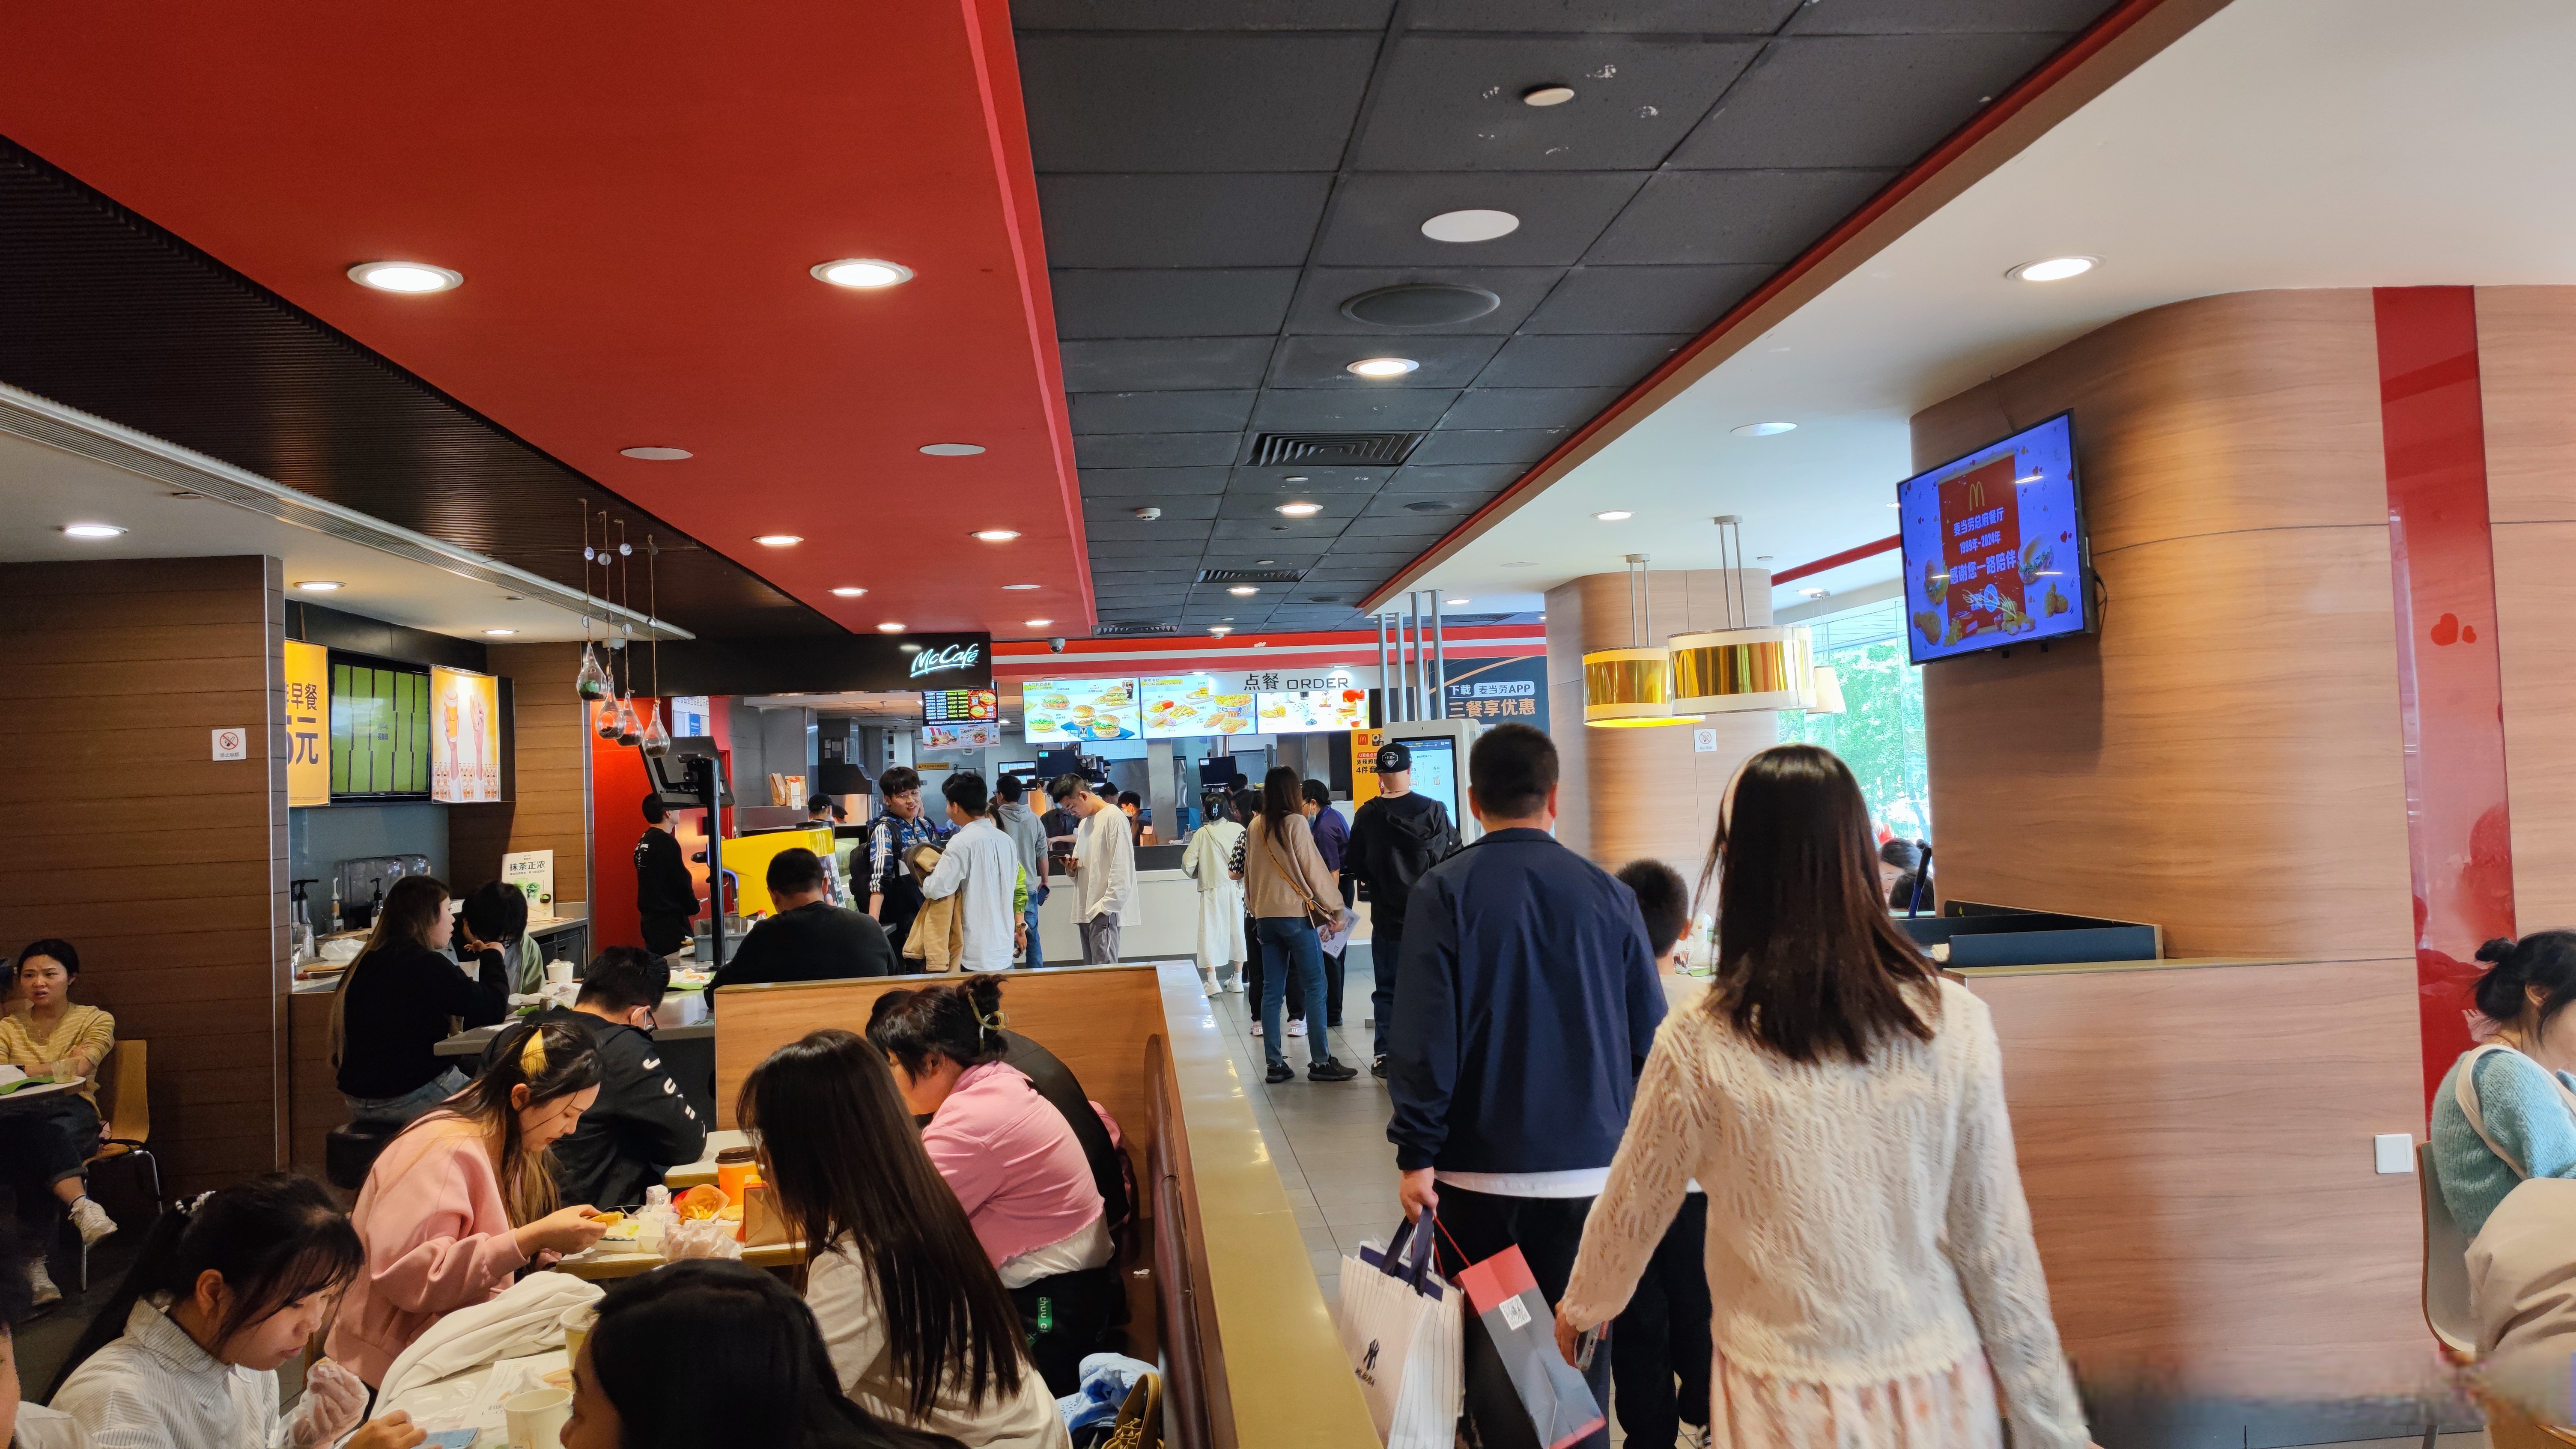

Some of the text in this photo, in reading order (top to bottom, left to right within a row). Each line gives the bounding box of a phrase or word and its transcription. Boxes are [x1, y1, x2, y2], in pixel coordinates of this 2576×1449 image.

[1953, 507, 2004, 537] 麦当劳总府餐厅
[1949, 549, 2016, 584] 感谢您一路陪伴
[1244, 673, 1349, 691] 点餐 ORDER
[1449, 684, 1531, 696] 下载 麦当劳APP
[286, 682, 317, 711] 早餐
[1449, 698, 1536, 718] 三餐享优惠
[510, 860, 546, 872] 抹茶正浓
[1039, 1297, 1048, 1318] chuu
